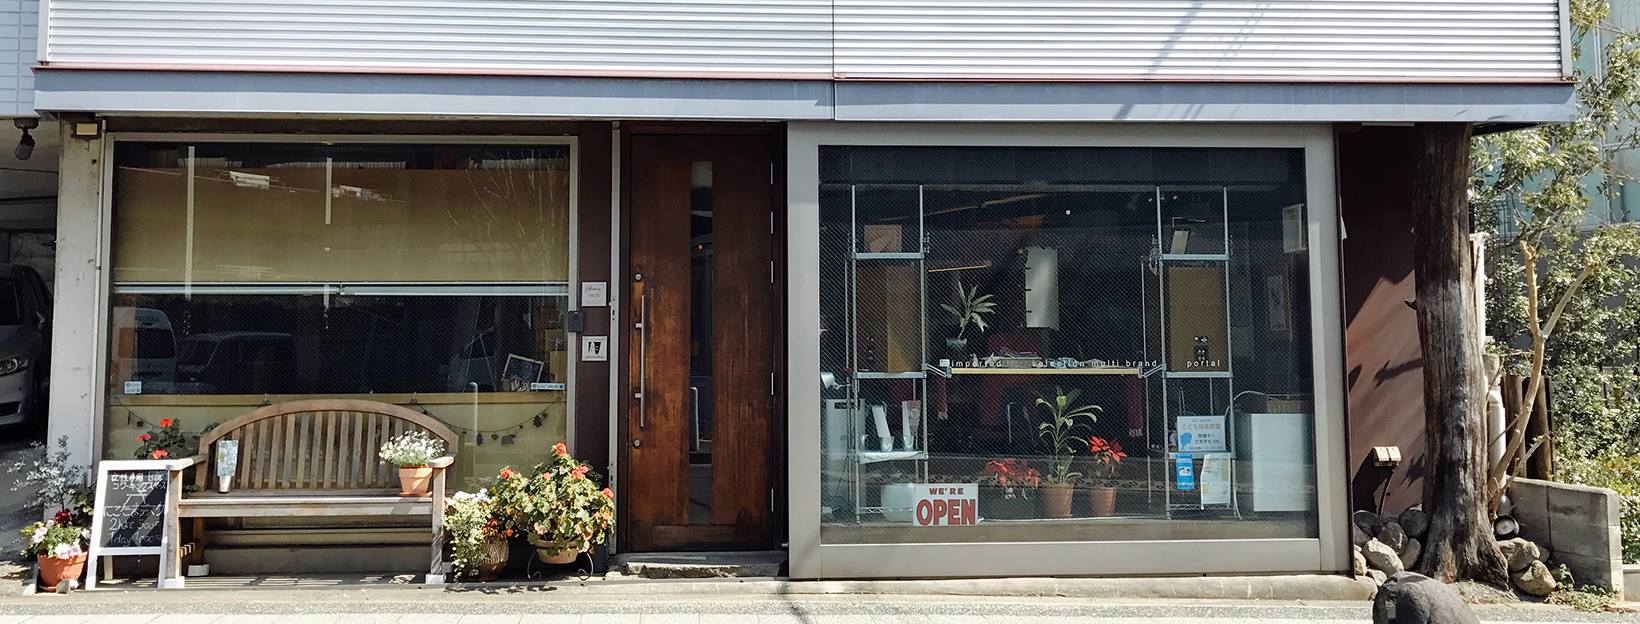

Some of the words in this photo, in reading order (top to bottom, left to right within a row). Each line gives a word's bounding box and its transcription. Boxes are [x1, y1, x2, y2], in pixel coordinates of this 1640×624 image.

[951, 359, 1002, 369] imported
[1031, 359, 1085, 368] selection
[1091, 359, 1120, 368] multi
[1125, 359, 1157, 368] brand
[1186, 359, 1221, 369] portal
[928, 487, 965, 495] WE'RE
[916, 498, 976, 526] OPEN
